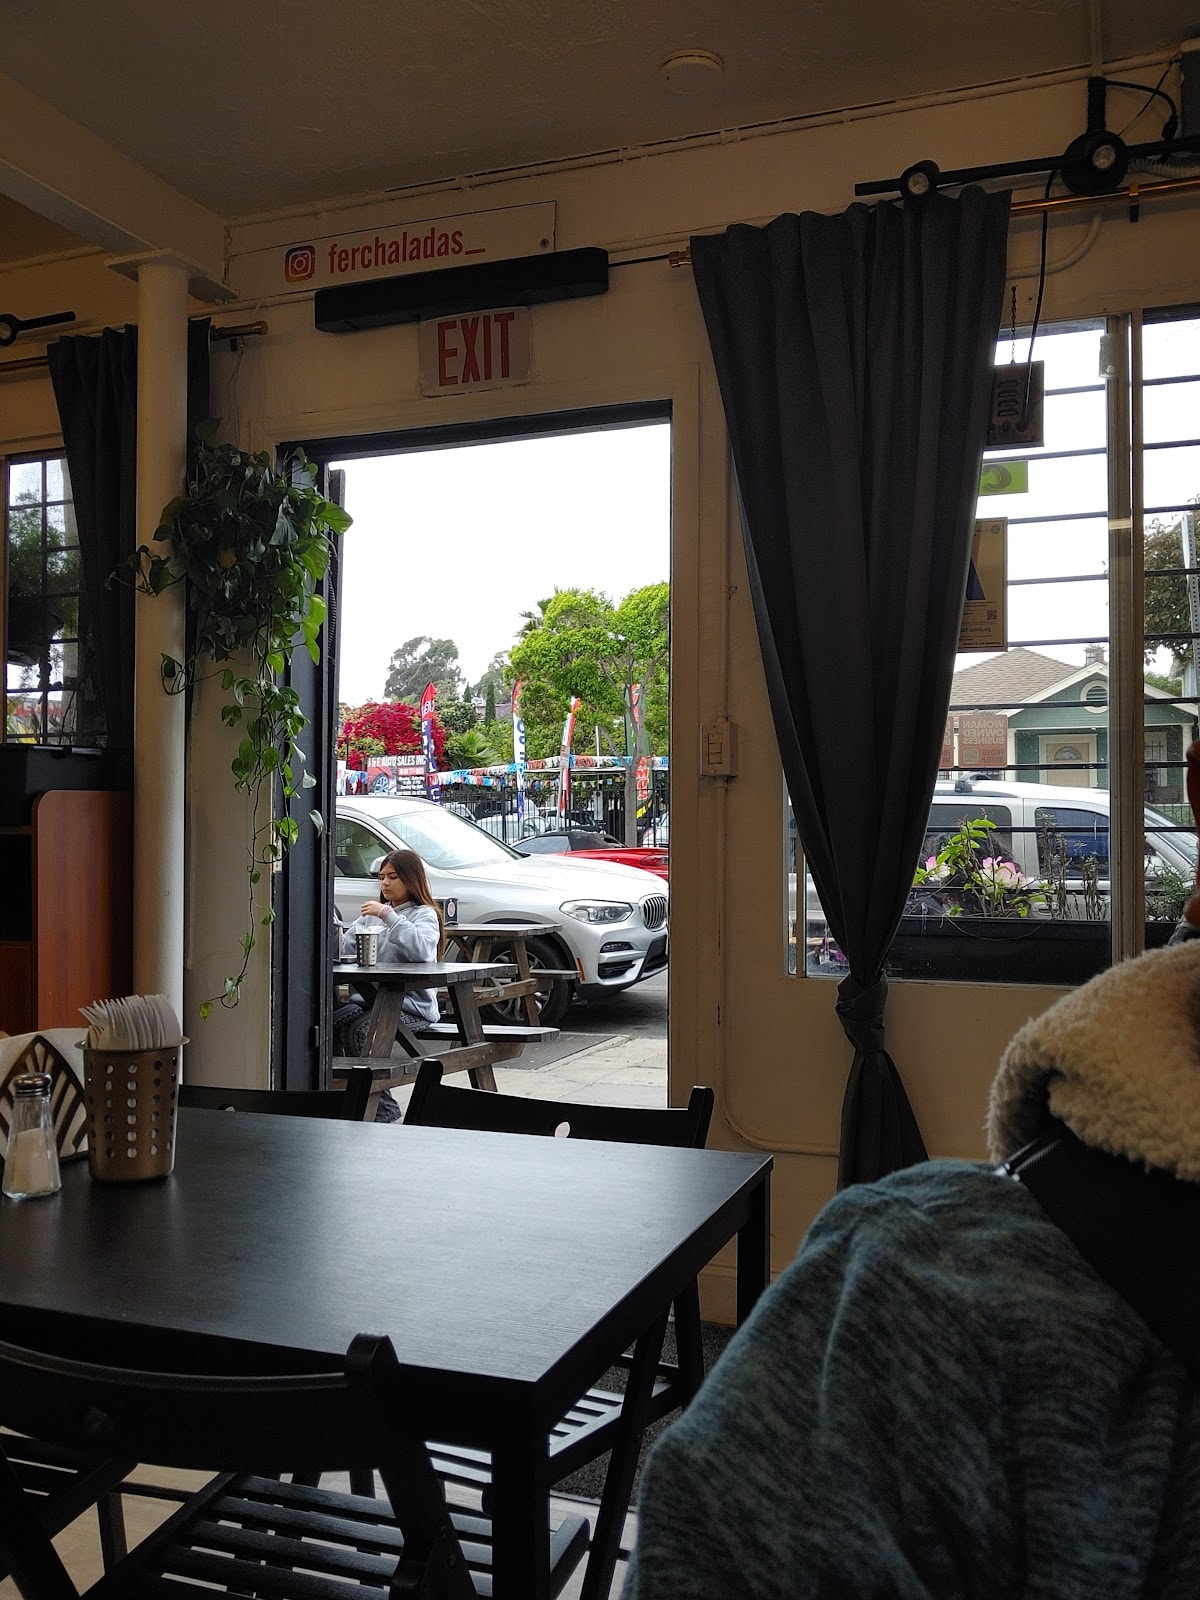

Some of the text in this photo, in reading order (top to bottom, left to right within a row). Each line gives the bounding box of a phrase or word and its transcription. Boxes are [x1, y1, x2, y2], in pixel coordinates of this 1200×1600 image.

[328, 226, 486, 275] ferchaladas_
[437, 312, 516, 388] EXIT
[382, 756, 396, 767] AUTO
[397, 755, 415, 766] SALES
[416, 754, 427, 765] INC
